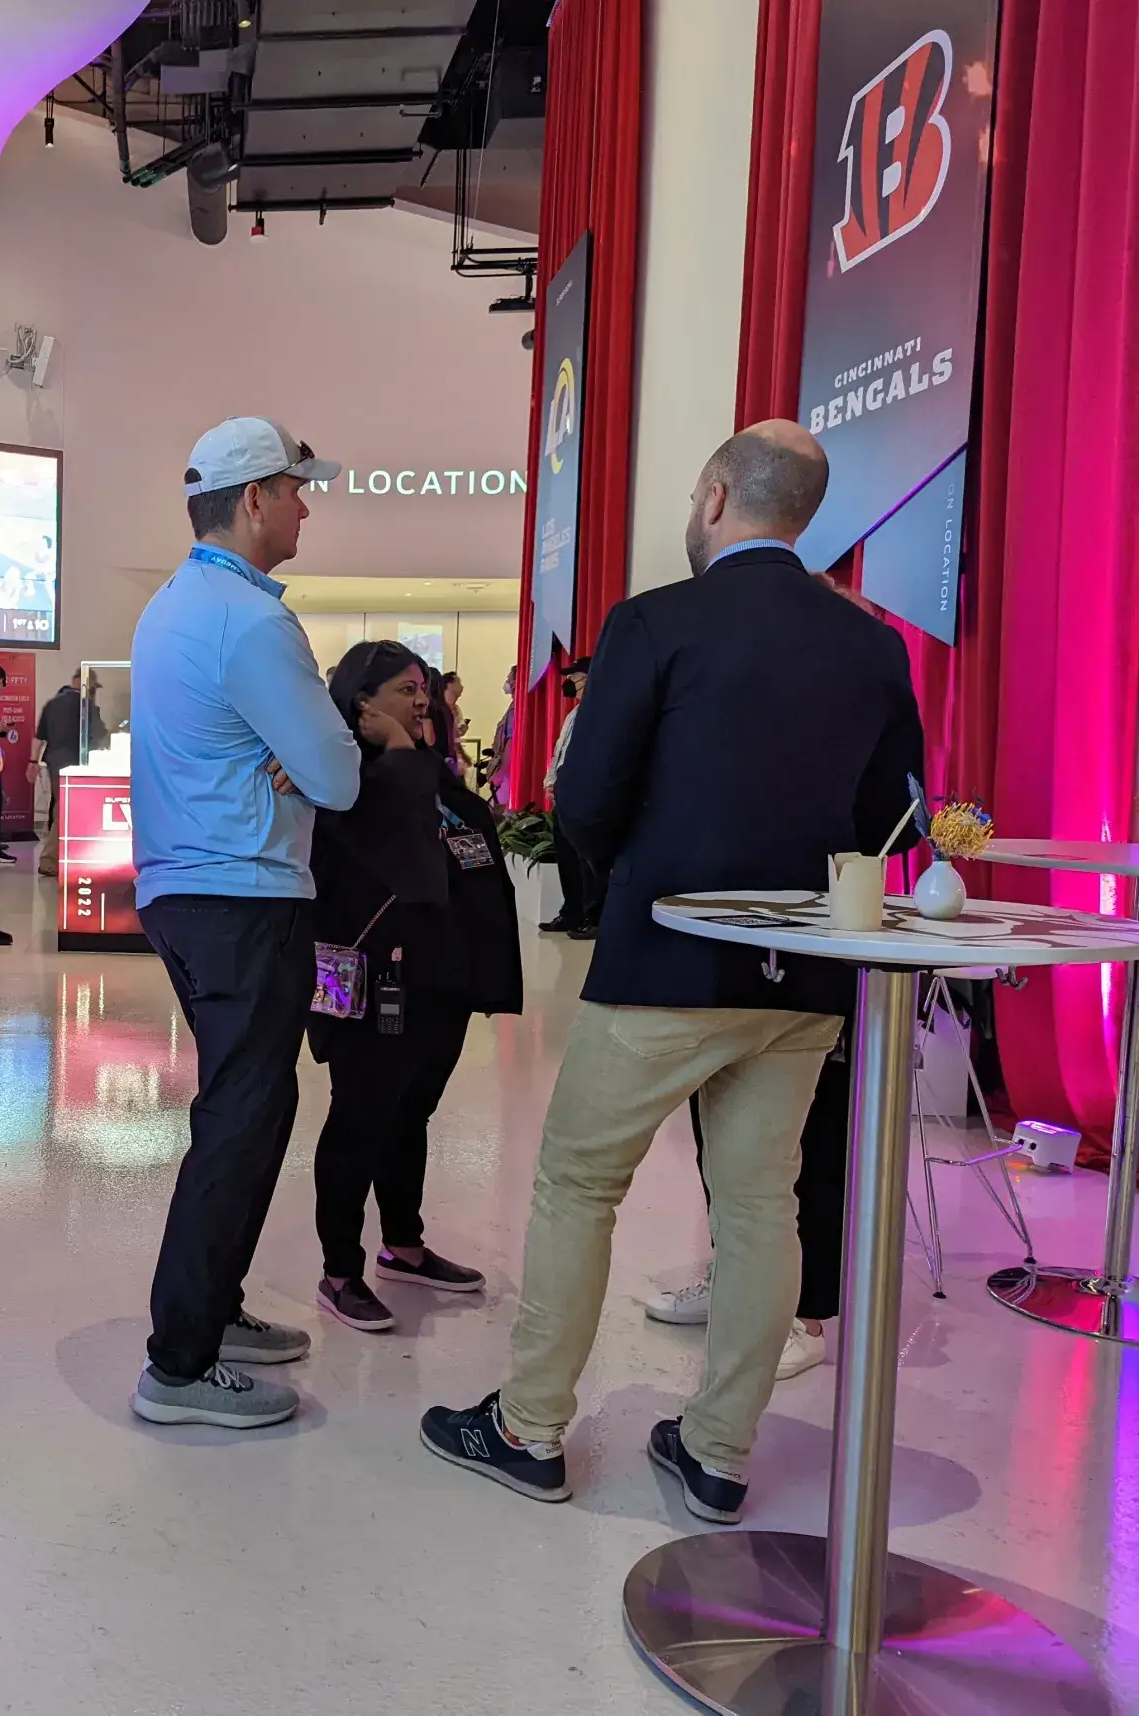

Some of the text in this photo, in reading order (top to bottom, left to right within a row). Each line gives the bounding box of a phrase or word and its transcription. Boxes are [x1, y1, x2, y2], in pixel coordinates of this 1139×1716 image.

[834, 336, 922, 389] CINCINNATI
[808, 348, 953, 435] BENGALS
[348, 469, 528, 495] LOCATION
[939, 483, 955, 611] ON LOCATION
[77, 877, 93, 917] 2022
[460, 1429, 490, 1458] N
